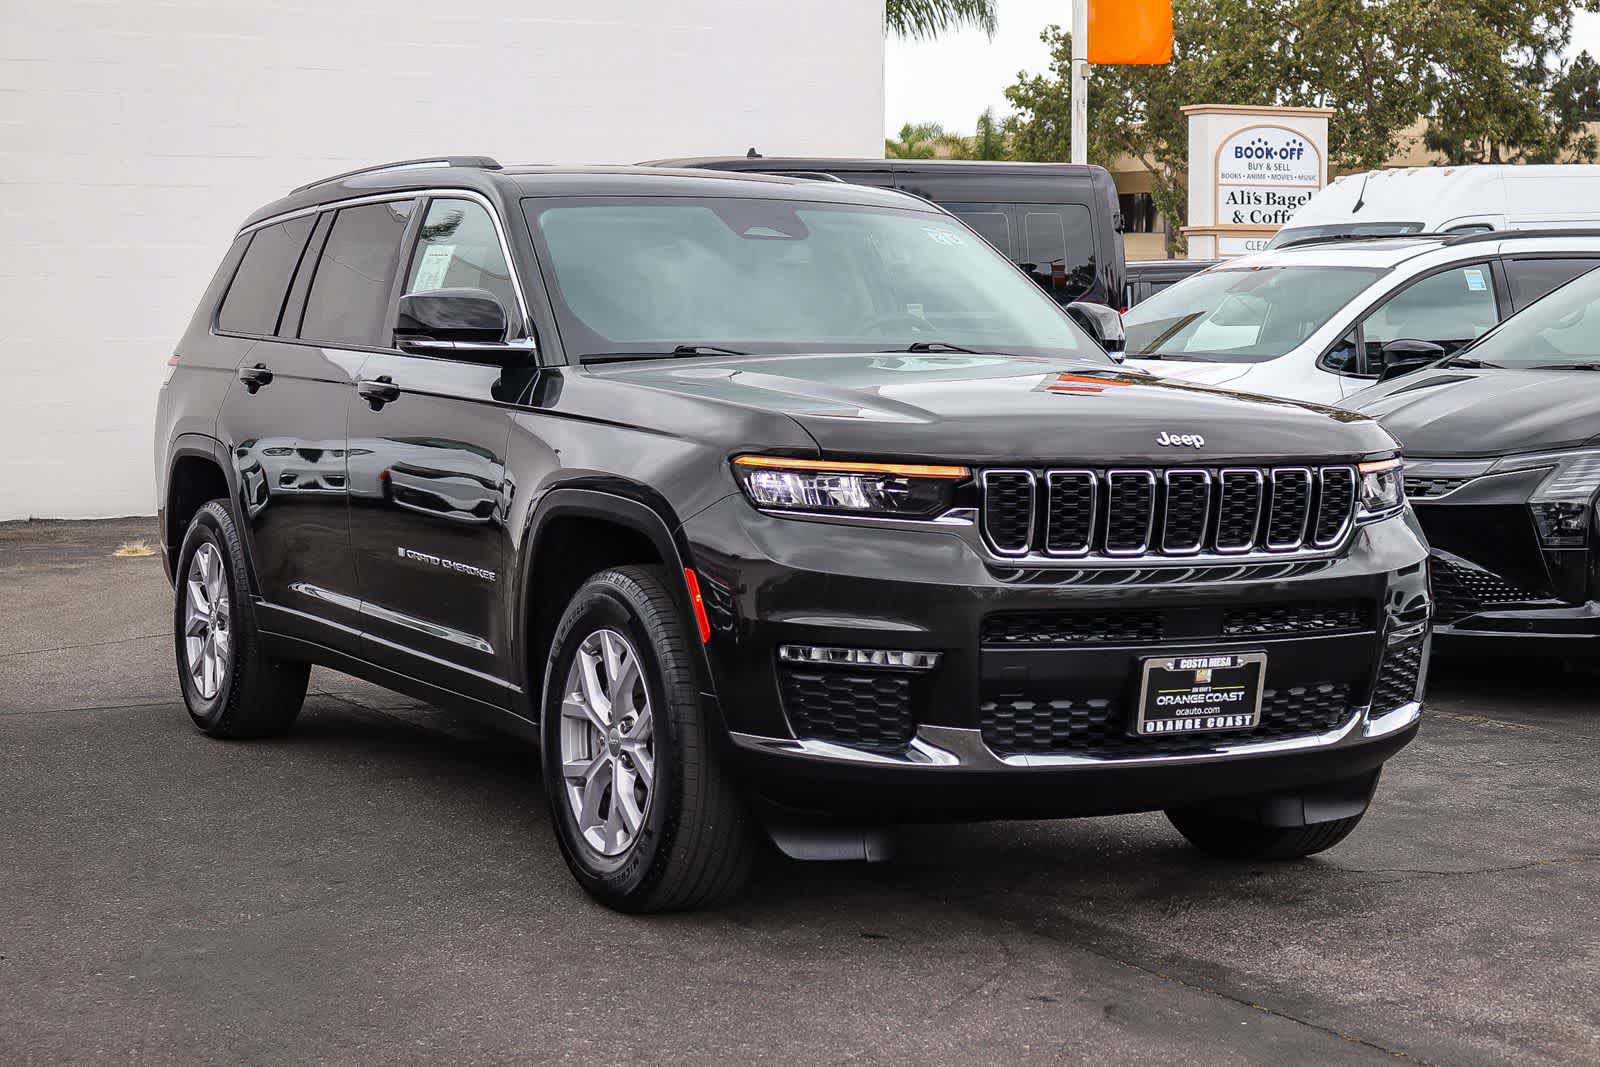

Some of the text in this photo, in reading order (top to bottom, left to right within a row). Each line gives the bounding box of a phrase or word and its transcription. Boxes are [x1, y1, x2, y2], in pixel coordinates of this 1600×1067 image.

[1248, 162, 1290, 171] BUY & SELL
[1221, 172, 1242, 180] BOOKS
[1225, 190, 1262, 205] Ali's
[1232, 209, 1244, 224] &
[1156, 431, 1204, 449] Jeep
[406, 549, 496, 581] GRAND CHEROKEE
[1180, 657, 1232, 669] COSTA MESA
[1175, 706, 1220, 716] ocauto.com
[1146, 715, 1252, 732] ORANGE COAST
